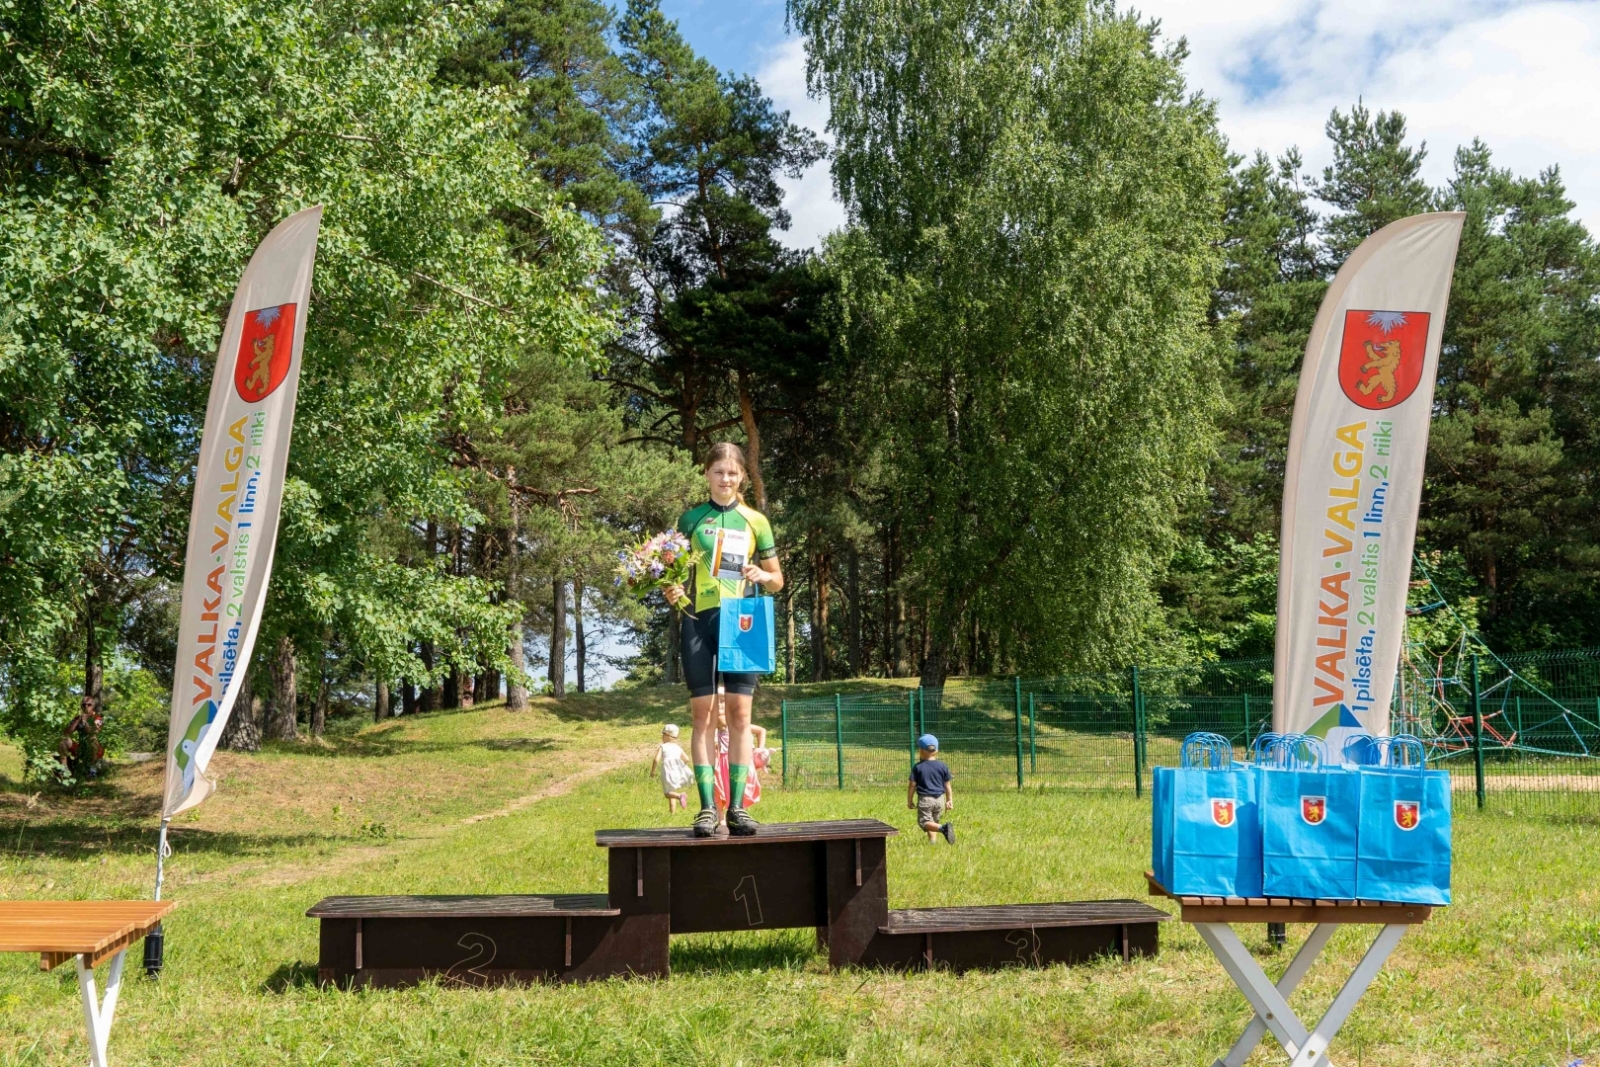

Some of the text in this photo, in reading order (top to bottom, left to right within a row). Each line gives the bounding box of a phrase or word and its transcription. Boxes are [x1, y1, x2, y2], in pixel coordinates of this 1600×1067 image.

[250, 411, 266, 447] riiki
[1373, 421, 1393, 457] riiki
[246, 453, 260, 469] 2
[1370, 464, 1388, 479] 2
[238, 470, 260, 515] linn,
[1363, 482, 1388, 524] linn,
[1363, 530, 1380, 538] 1
[231, 534, 250, 598] valstis
[1360, 542, 1380, 607] valstis
[226, 603, 242, 617] 2
[1357, 611, 1376, 625] 2
[733, 874, 764, 926] 1
[445, 932, 497, 989] 2
[1001, 929, 1041, 968] 3
